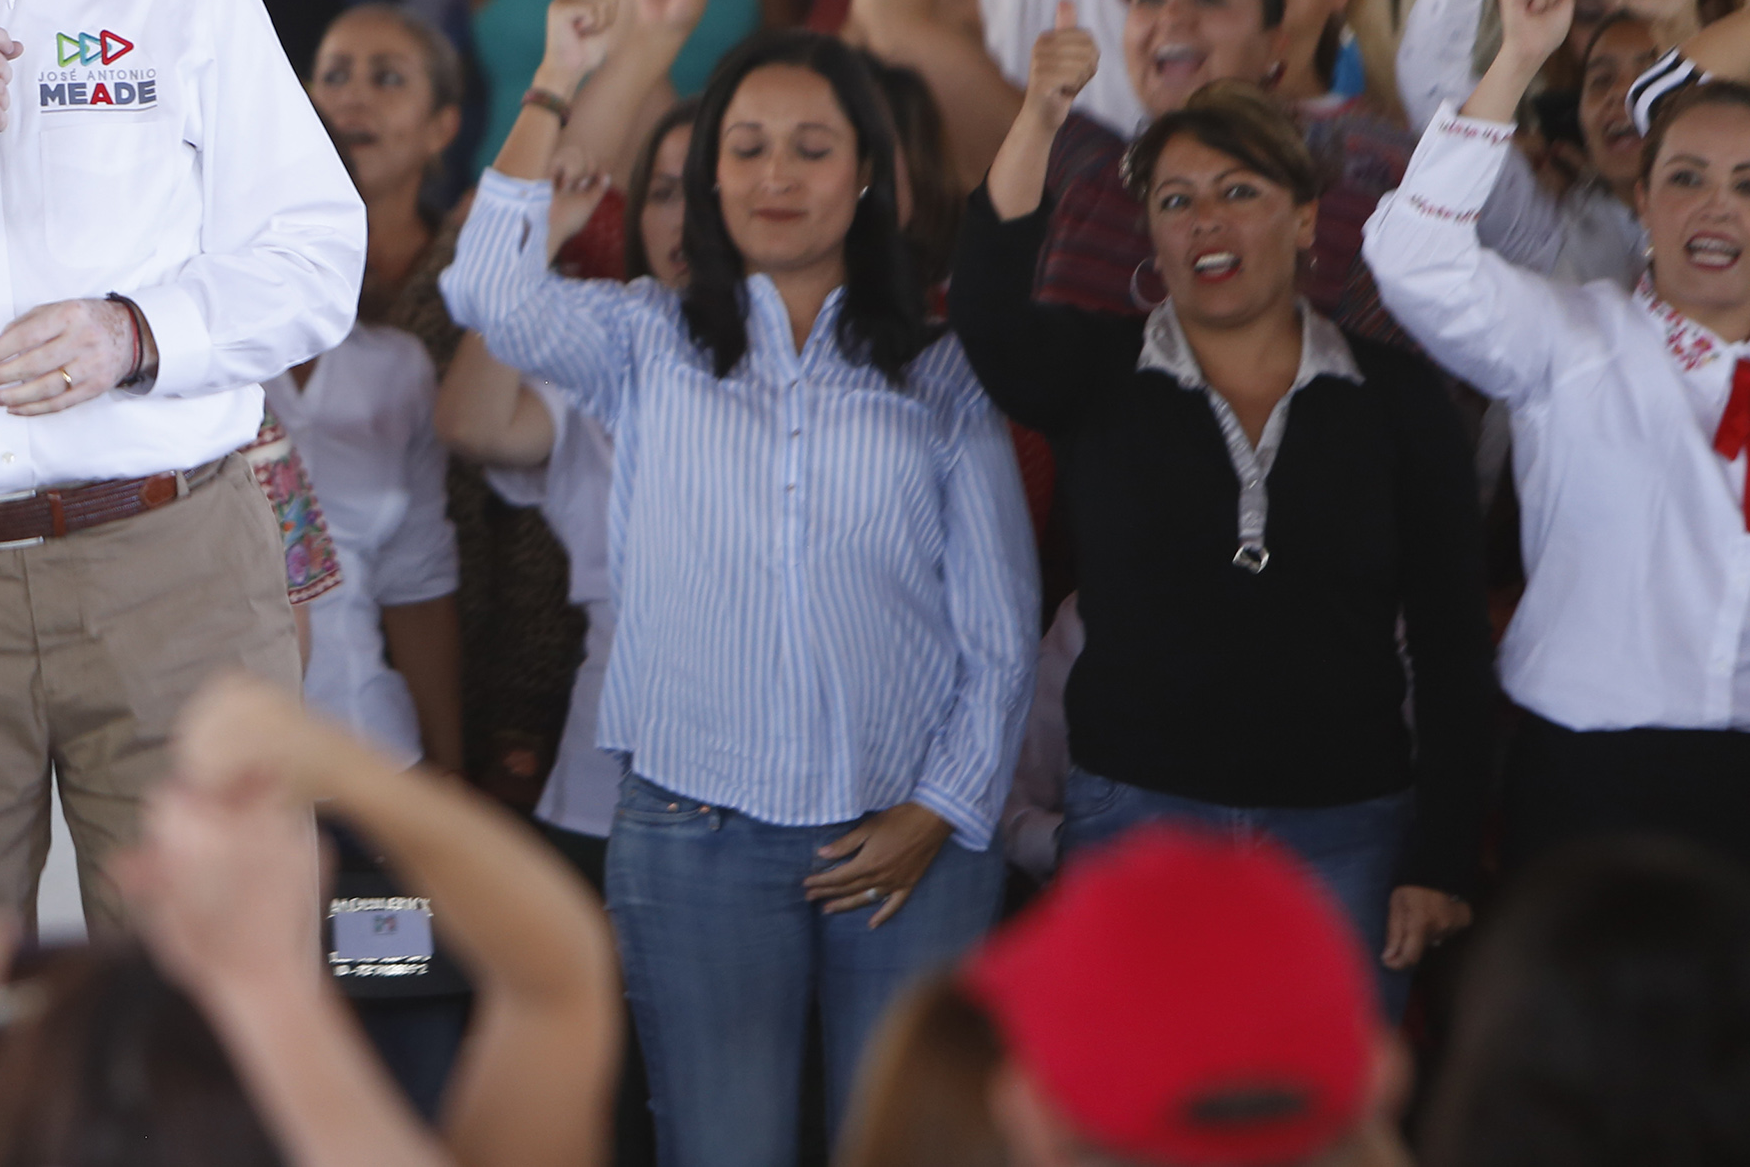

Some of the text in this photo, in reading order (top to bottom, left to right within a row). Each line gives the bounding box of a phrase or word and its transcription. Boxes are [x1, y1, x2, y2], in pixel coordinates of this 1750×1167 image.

[38, 68, 157, 82] JOSÉ ANTONIO
[40, 80, 157, 107] MEADE
